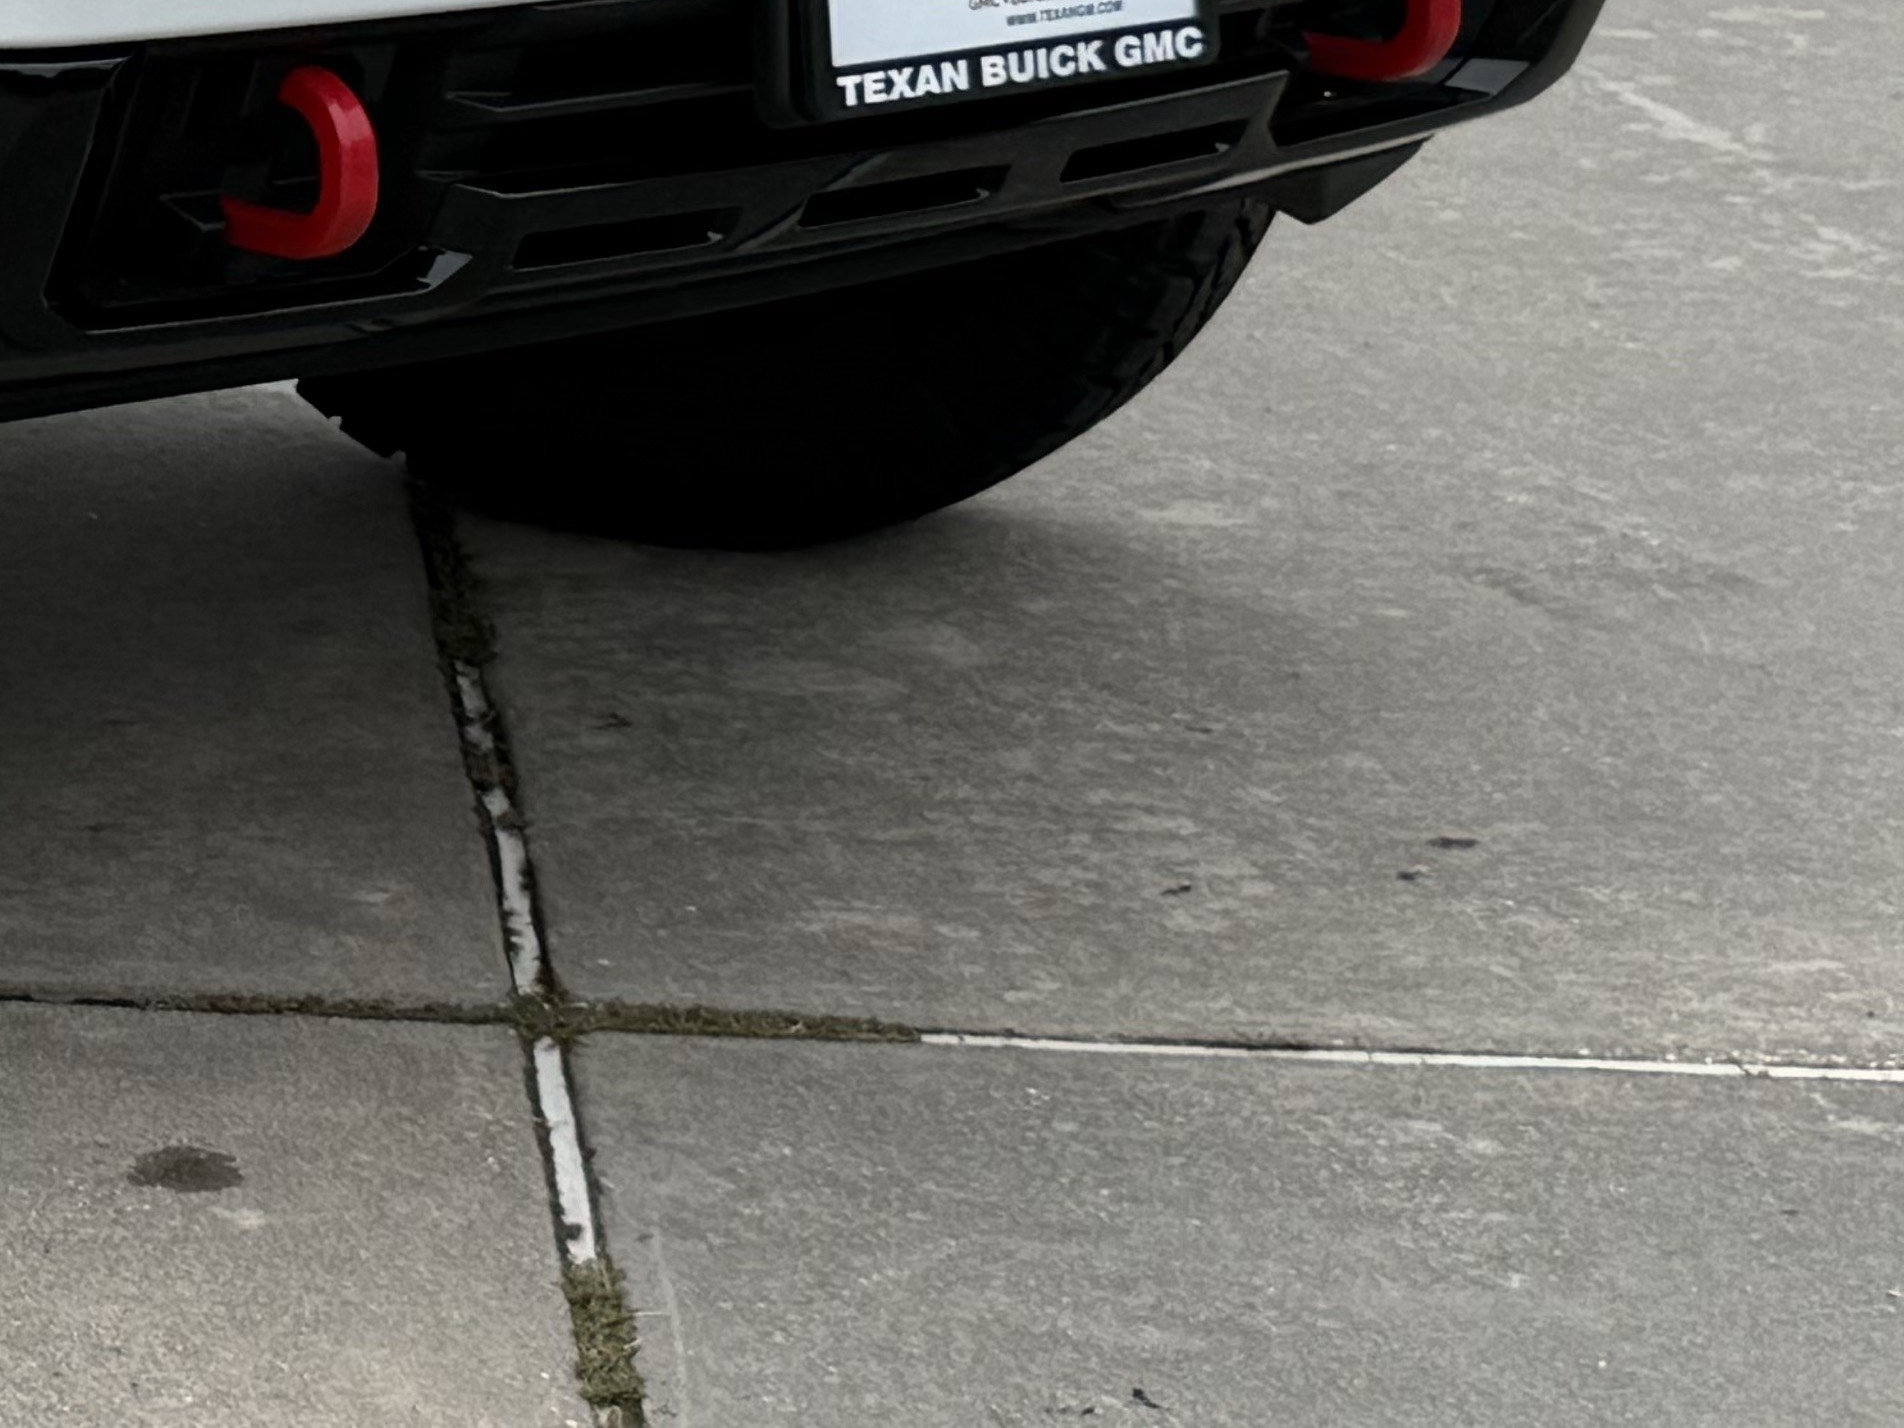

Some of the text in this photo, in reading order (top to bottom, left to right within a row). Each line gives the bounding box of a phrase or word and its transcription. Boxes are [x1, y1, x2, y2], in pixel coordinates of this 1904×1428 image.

[836, 25, 1204, 107] TEXAN BUICK GMC
